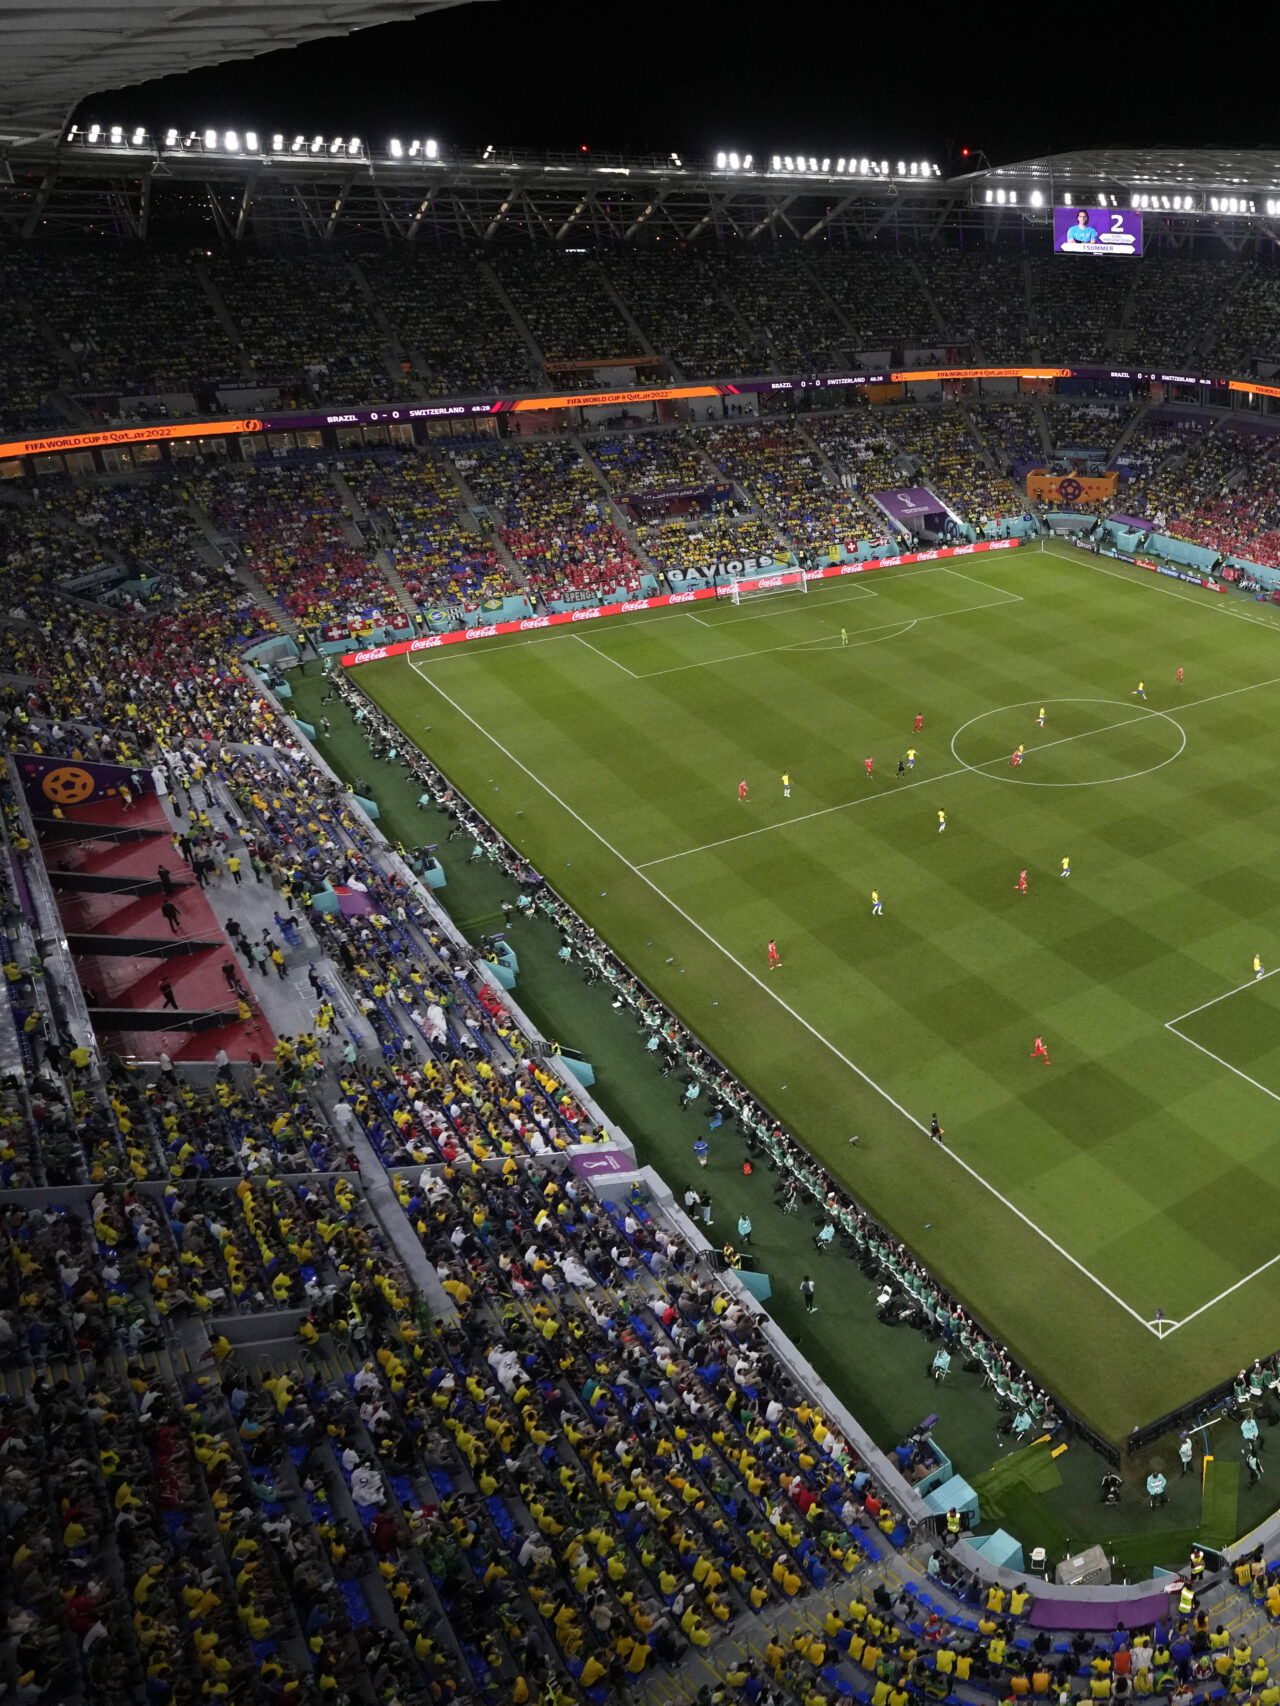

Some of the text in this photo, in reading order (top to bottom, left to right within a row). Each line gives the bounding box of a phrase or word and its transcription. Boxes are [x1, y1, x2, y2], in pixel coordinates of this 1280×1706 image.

[1111, 215, 1123, 232] 2
[827, 377, 866, 385] SWITZERLAND
[327, 415, 358, 423] BRAZIL
[370, 412, 378, 420] 0
[392, 411, 399, 419] 0
[409, 407, 465, 417] SWITZERLAND
[25, 441, 45, 451] FIFA
[50, 437, 81, 448] WORLD
[83, 436, 100, 445] CUP
[880, 556, 901, 567] Coca-Cola
[917, 550, 939, 561] Coca-Cola
[841, 562, 864, 575] Coca-Cola
[669, 592, 696, 604] Coca-Cola
[622, 599, 650, 612] Coca-Cola
[572, 608, 601, 621] Coca-Cola
[520, 616, 551, 630] Coca-Cola
[466, 626, 498, 640] Coca-Cola
[411, 636, 443, 650] Coca-Cola
[355, 648, 388, 663] Coca-Cola
